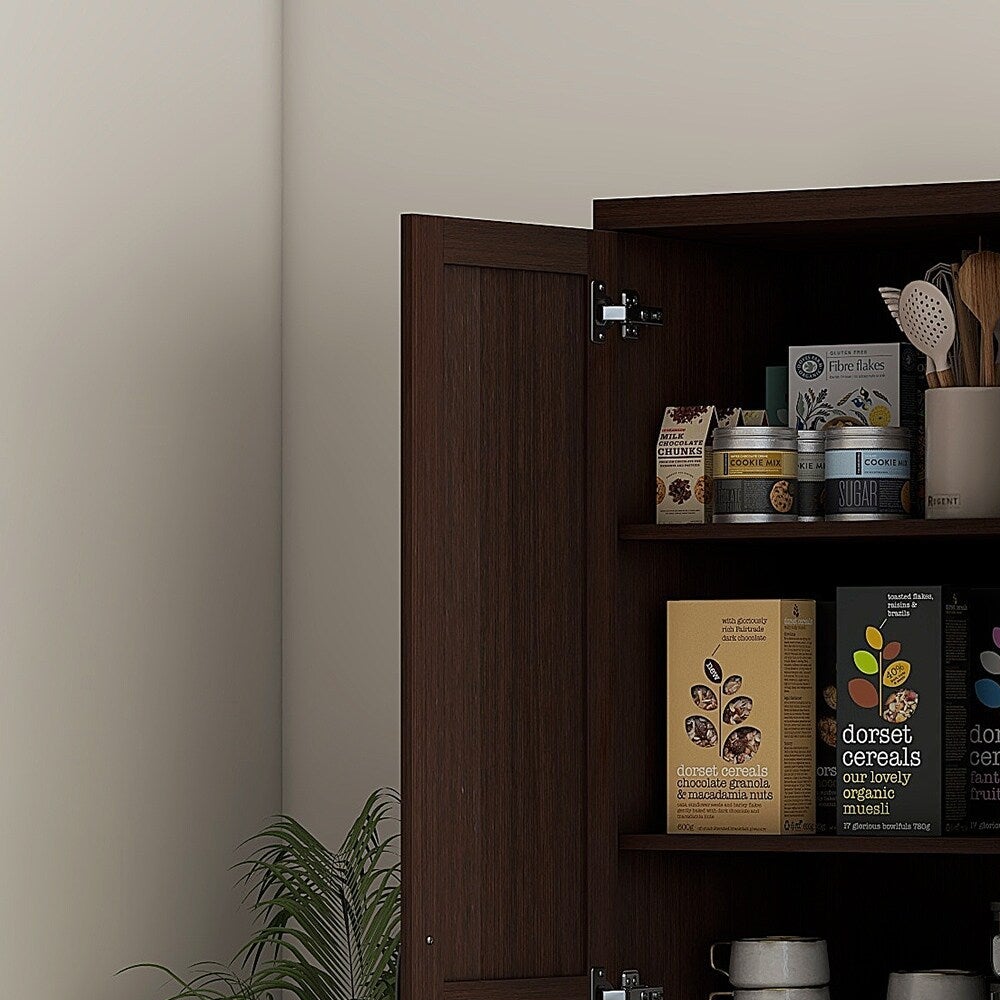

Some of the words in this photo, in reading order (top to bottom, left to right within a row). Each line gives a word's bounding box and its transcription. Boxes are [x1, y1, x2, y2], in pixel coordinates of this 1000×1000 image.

[829, 359, 854, 372] Fibre
[857, 358, 885, 371] flakes
[657, 447, 703, 456] CHUNKS
[730, 459, 763, 467] COOKIE
[765, 459, 781, 467] MIX
[797, 462, 813, 470] KIE
[864, 459, 896, 467] COOKIE
[839, 480, 878, 507] SUGAR
[705, 661, 720, 681] new
[886, 664, 905, 680] 40%
[842, 723, 913, 744] dorset
[842, 746, 922, 767] cereals
[676, 763, 719, 777] dorset
[721, 763, 768, 777] cereals
[676, 777, 727, 789] chocolate
[728, 777, 771, 790] granola
[842, 772, 868, 784] our
[870, 770, 912, 787] lovely
[676, 789, 687, 800] &
[687, 789, 748, 800] macadamia
[749, 789, 774, 800] nuts
[842, 786, 895, 802] organic
[842, 802, 890, 815] muesli
[852, 822, 881, 831] glorious
[881, 822, 912, 830] bowlfuls
